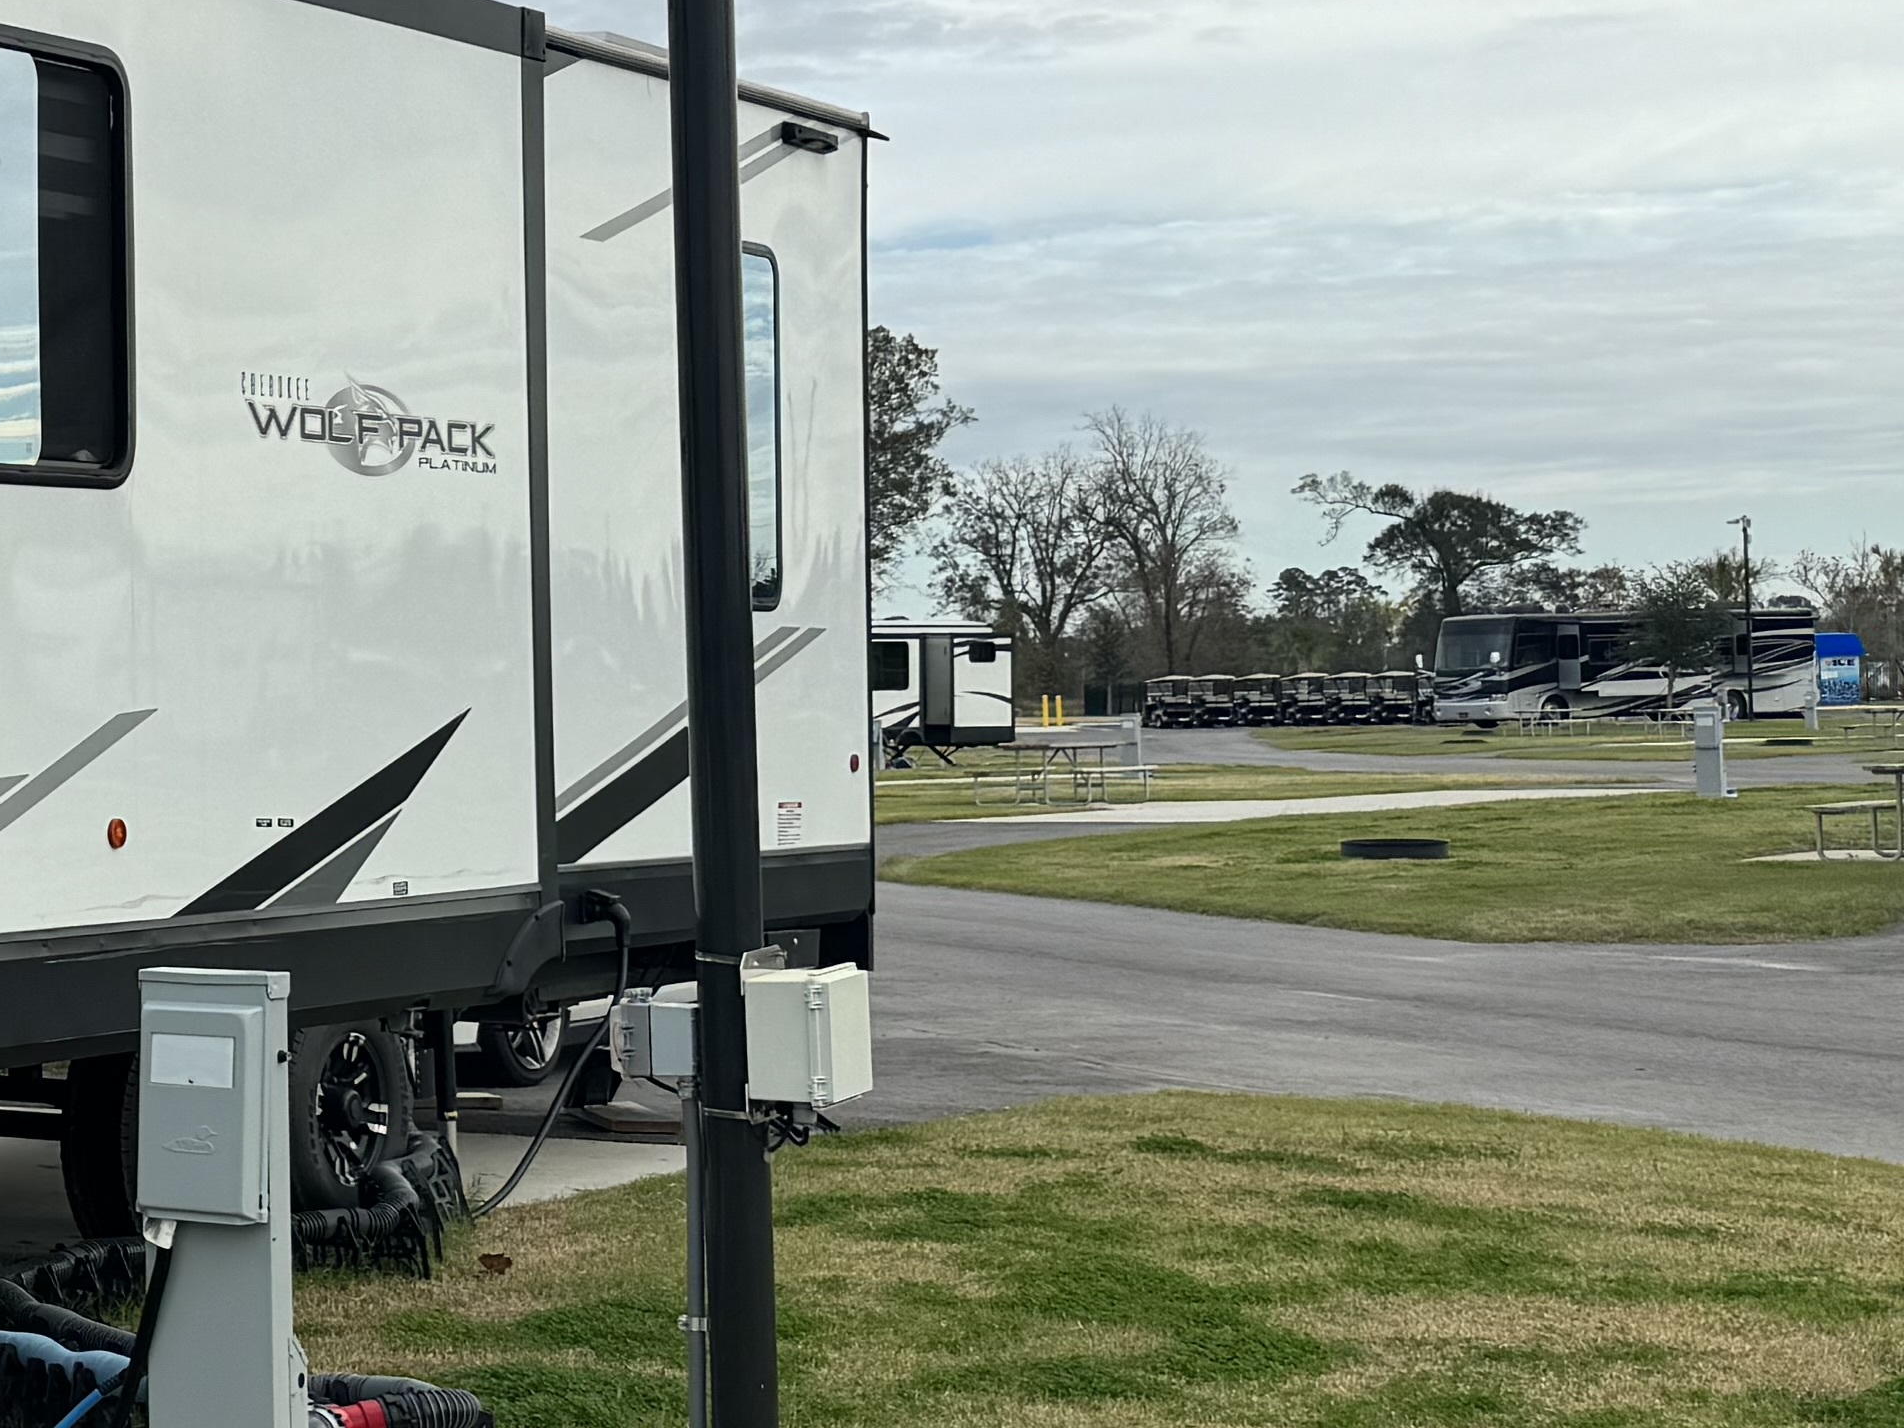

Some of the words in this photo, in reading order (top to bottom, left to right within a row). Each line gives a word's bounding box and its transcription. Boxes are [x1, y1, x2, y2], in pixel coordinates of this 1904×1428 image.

[245, 398, 385, 446] WOLF
[393, 414, 496, 459] PACK
[417, 456, 497, 475] PLATINUM
